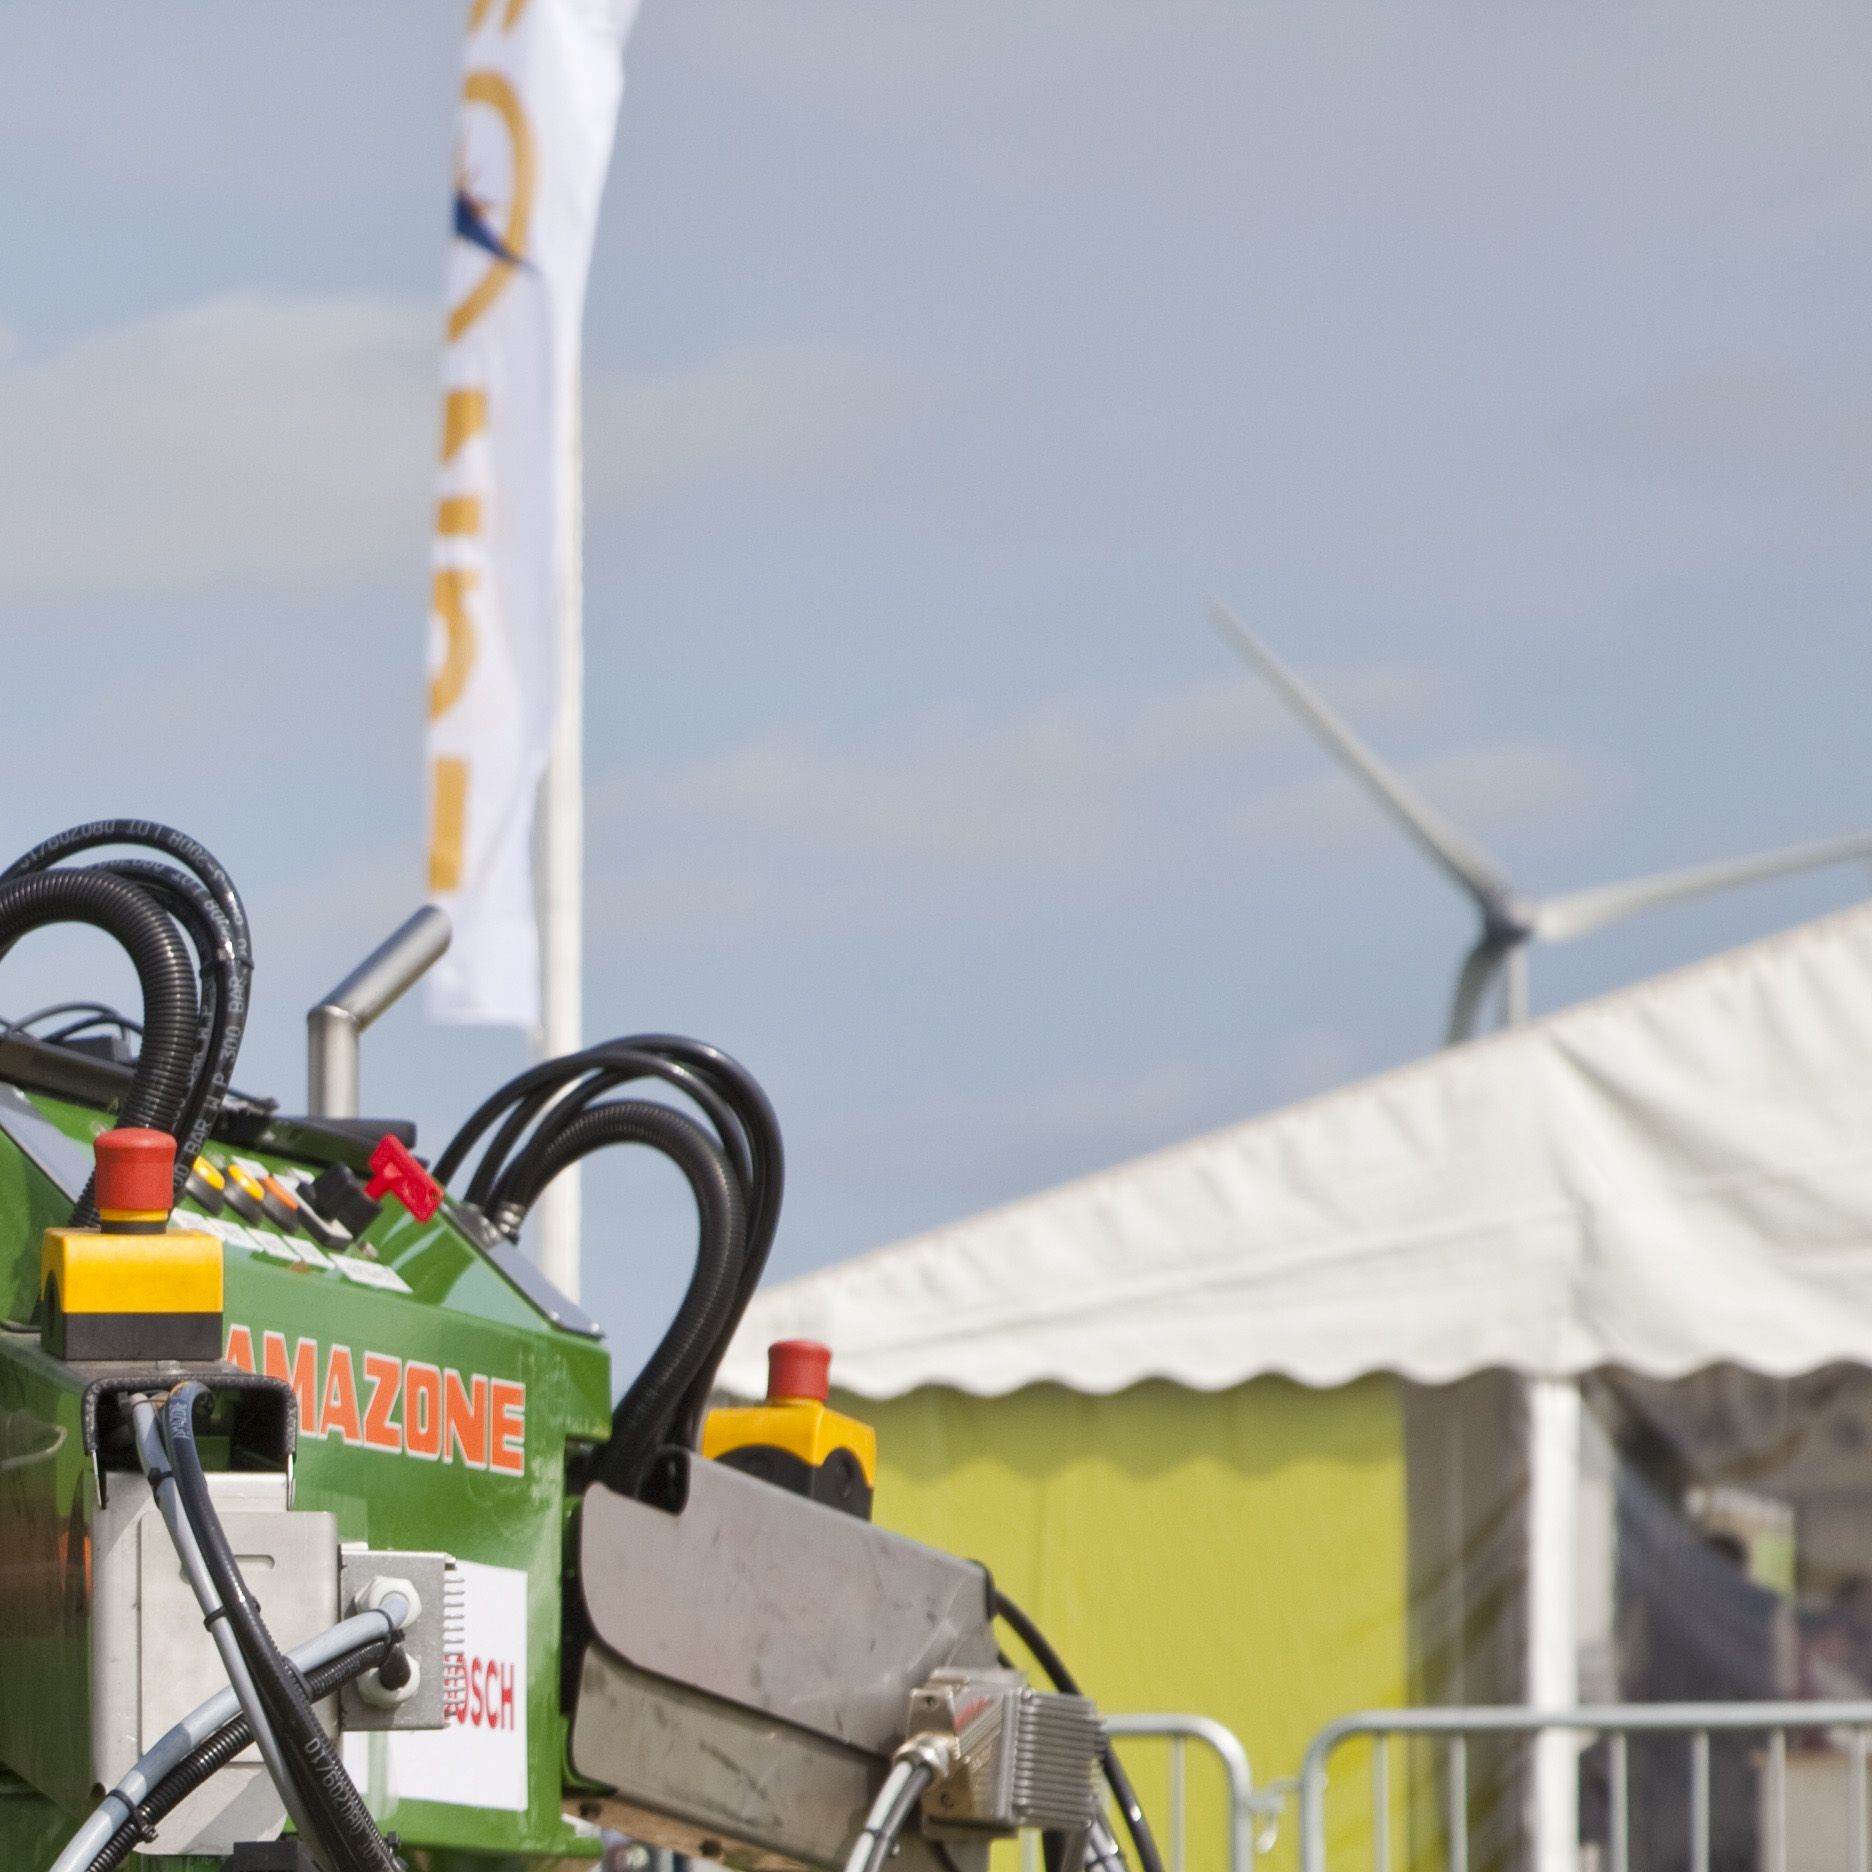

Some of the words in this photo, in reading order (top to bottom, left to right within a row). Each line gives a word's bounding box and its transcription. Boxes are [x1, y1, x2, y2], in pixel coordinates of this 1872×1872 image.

[228, 975, 246, 1012] BAR
[220, 1025, 241, 1063] 300
[184, 1118, 212, 1155] BAR
